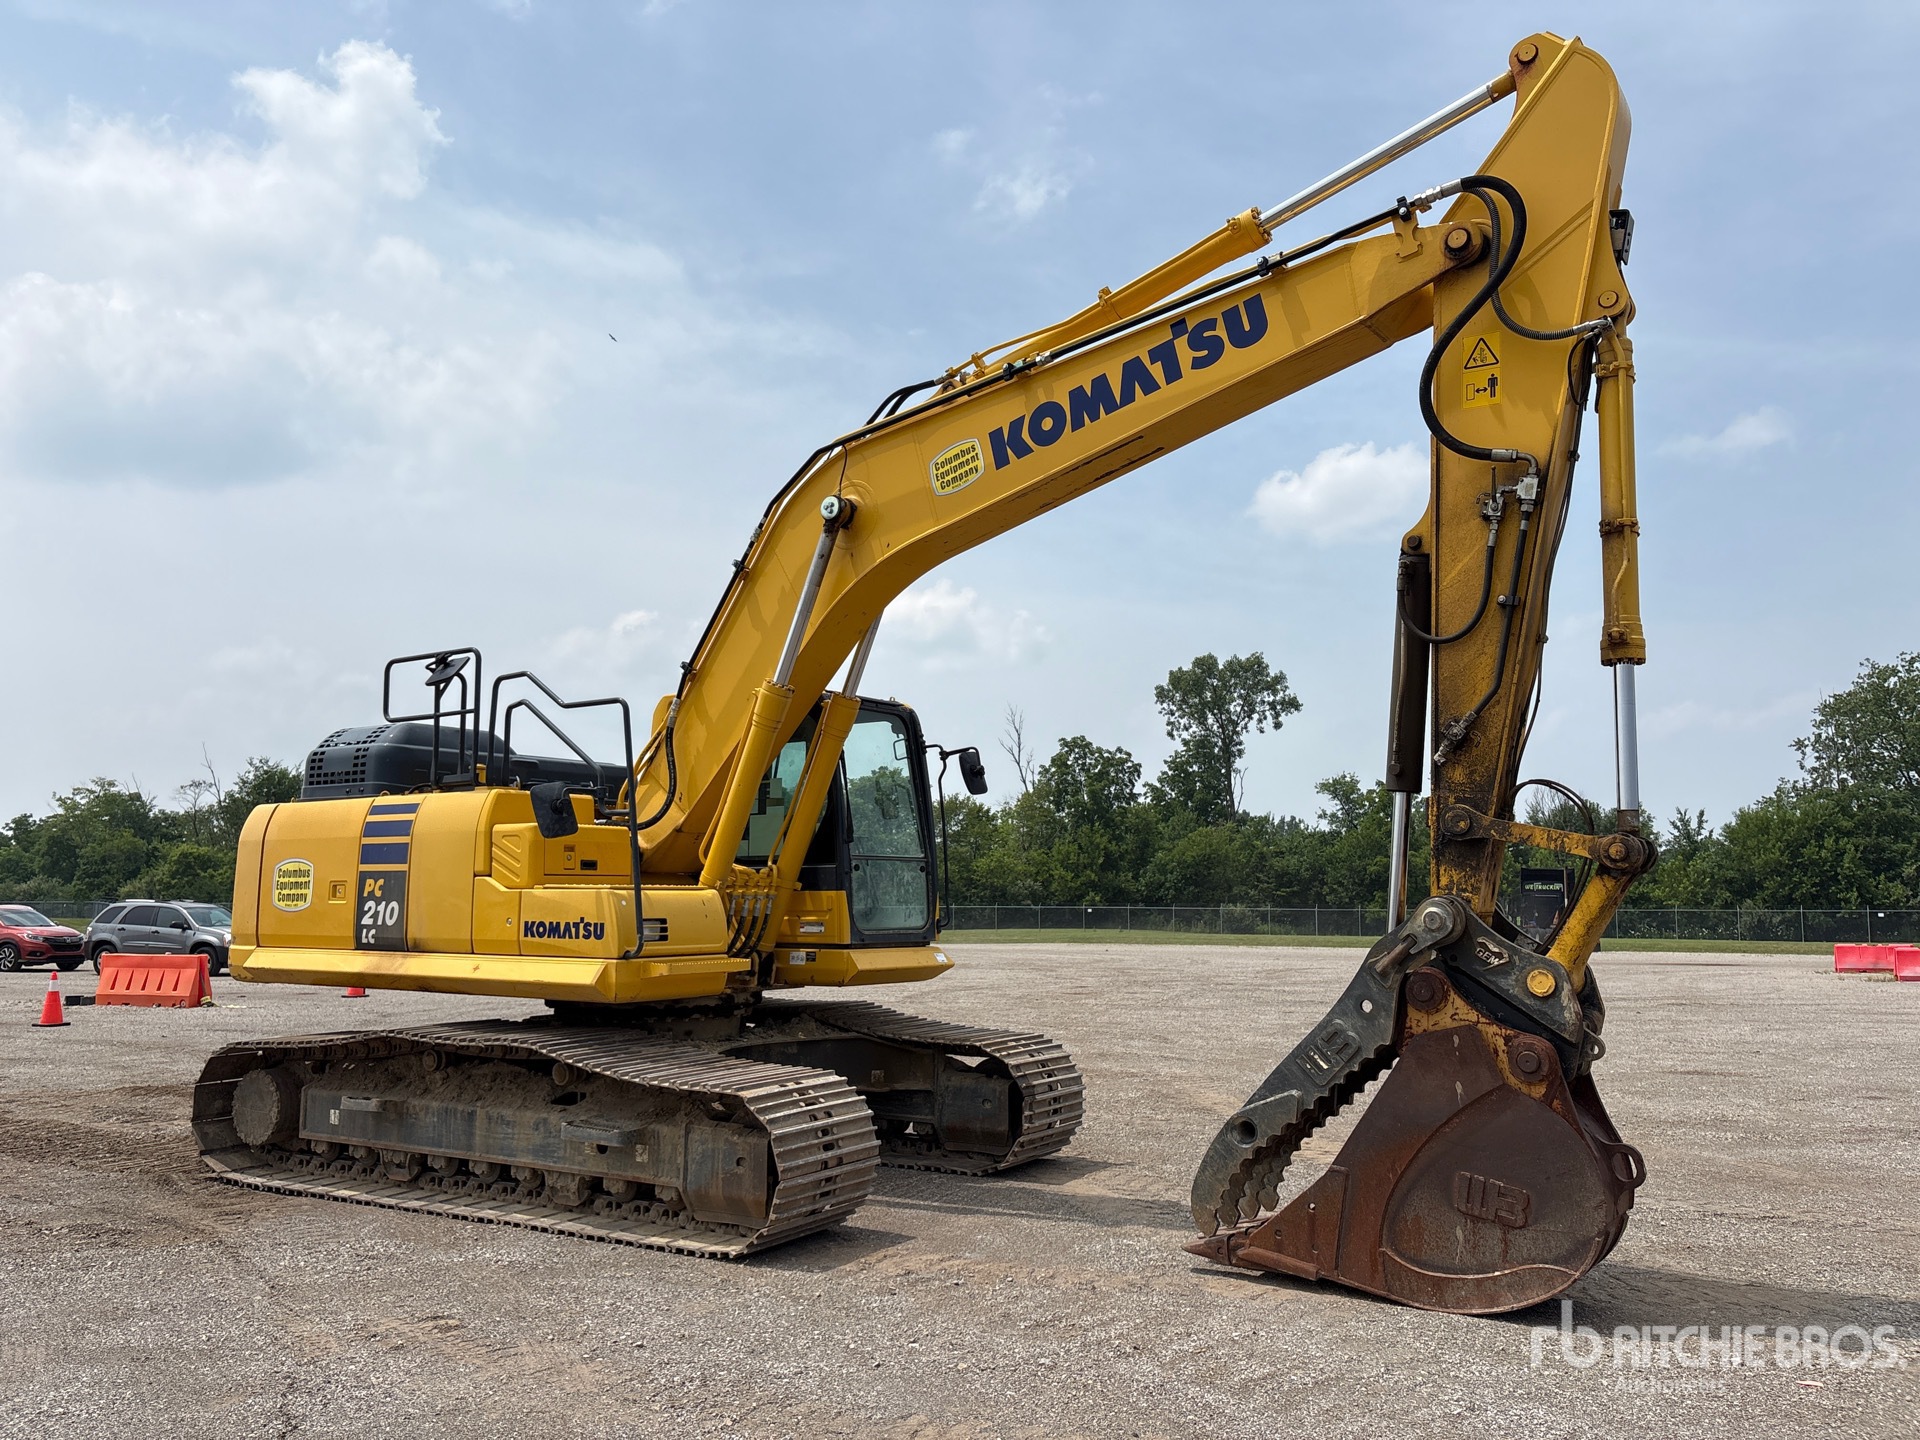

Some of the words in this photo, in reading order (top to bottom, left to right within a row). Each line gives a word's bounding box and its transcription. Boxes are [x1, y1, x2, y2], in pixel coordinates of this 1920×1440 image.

[988, 293, 1268, 470] KOMATSU
[934, 444, 976, 471] Columbus
[935, 453, 979, 482] Equipment
[940, 464, 978, 490] Company
[278, 868, 310, 878] Columbus
[276, 880, 310, 891] Equipment
[363, 878, 384, 897] PC
[277, 892, 307, 903] Company
[361, 900, 399, 926] 210
[361, 928, 376, 944] LC
[523, 917, 605, 940] KOMATSU
[1475, 947, 1500, 965] GEM
